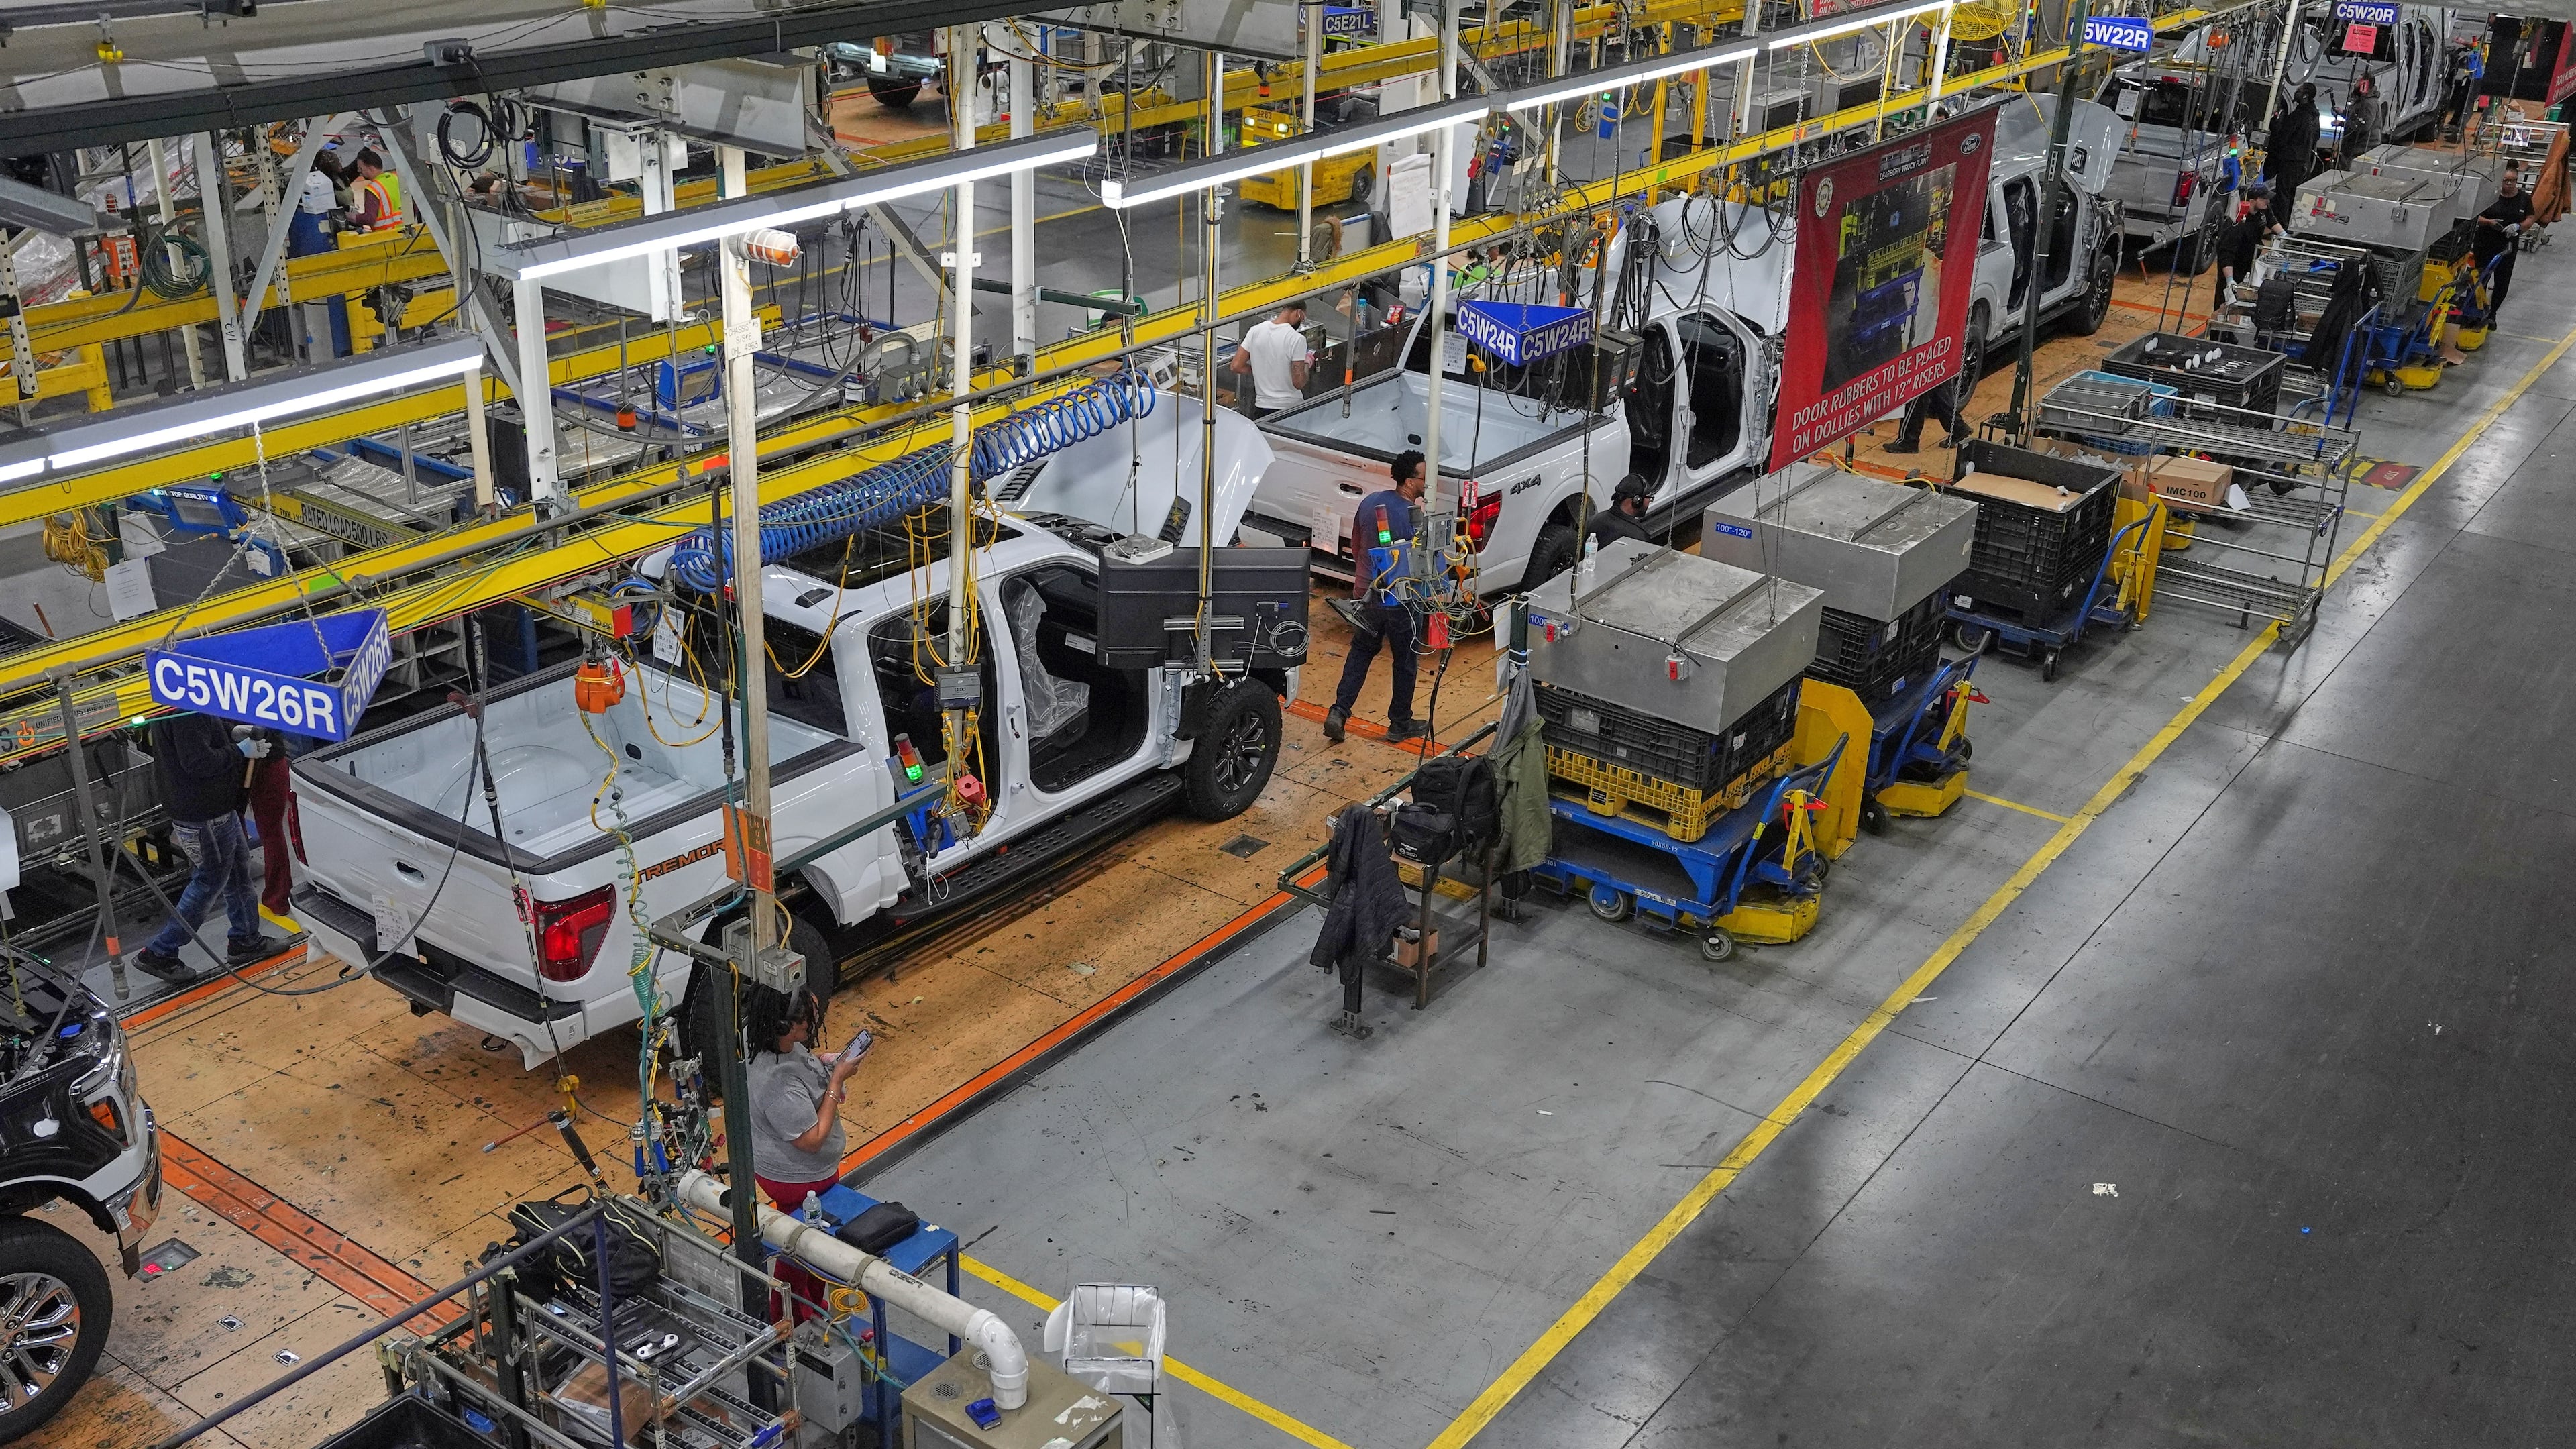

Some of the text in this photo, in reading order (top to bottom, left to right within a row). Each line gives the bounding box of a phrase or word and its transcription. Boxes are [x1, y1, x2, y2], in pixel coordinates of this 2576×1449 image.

[1325, 13, 1370, 32] C5E21L
[2336, 3, 2394, 23] C5W20R
[2070, 22, 2149, 49] 5W22R
[1879, 167, 1901, 181] DEARBORN
[1901, 162, 1917, 172] TRUCK
[729, 324, 749, 336] CHASSIS
[1458, 305, 1516, 362] C5W24R
[1521, 317, 1591, 361] C5W24R
[1792, 336, 1951, 431] DOOR RUBBERS TO BE PLACED
[1792, 429, 1810, 453] ON
[1814, 405, 1860, 443] DOLLIES
[1863, 389, 1890, 417] WITH
[1912, 360, 1946, 392] RISERS
[184, 491, 209, 501] QUALITY
[2166, 486, 2206, 499] IMC100
[301, 503, 327, 530] RATED
[329, 513, 352, 541] LOAD
[352, 521, 368, 545] 500
[343, 621, 392, 727] C5W26R
[154, 658, 336, 734] C5W26R
[36, 715, 62, 729] UNIFIED
[630, 838, 725, 885] TREMOR
